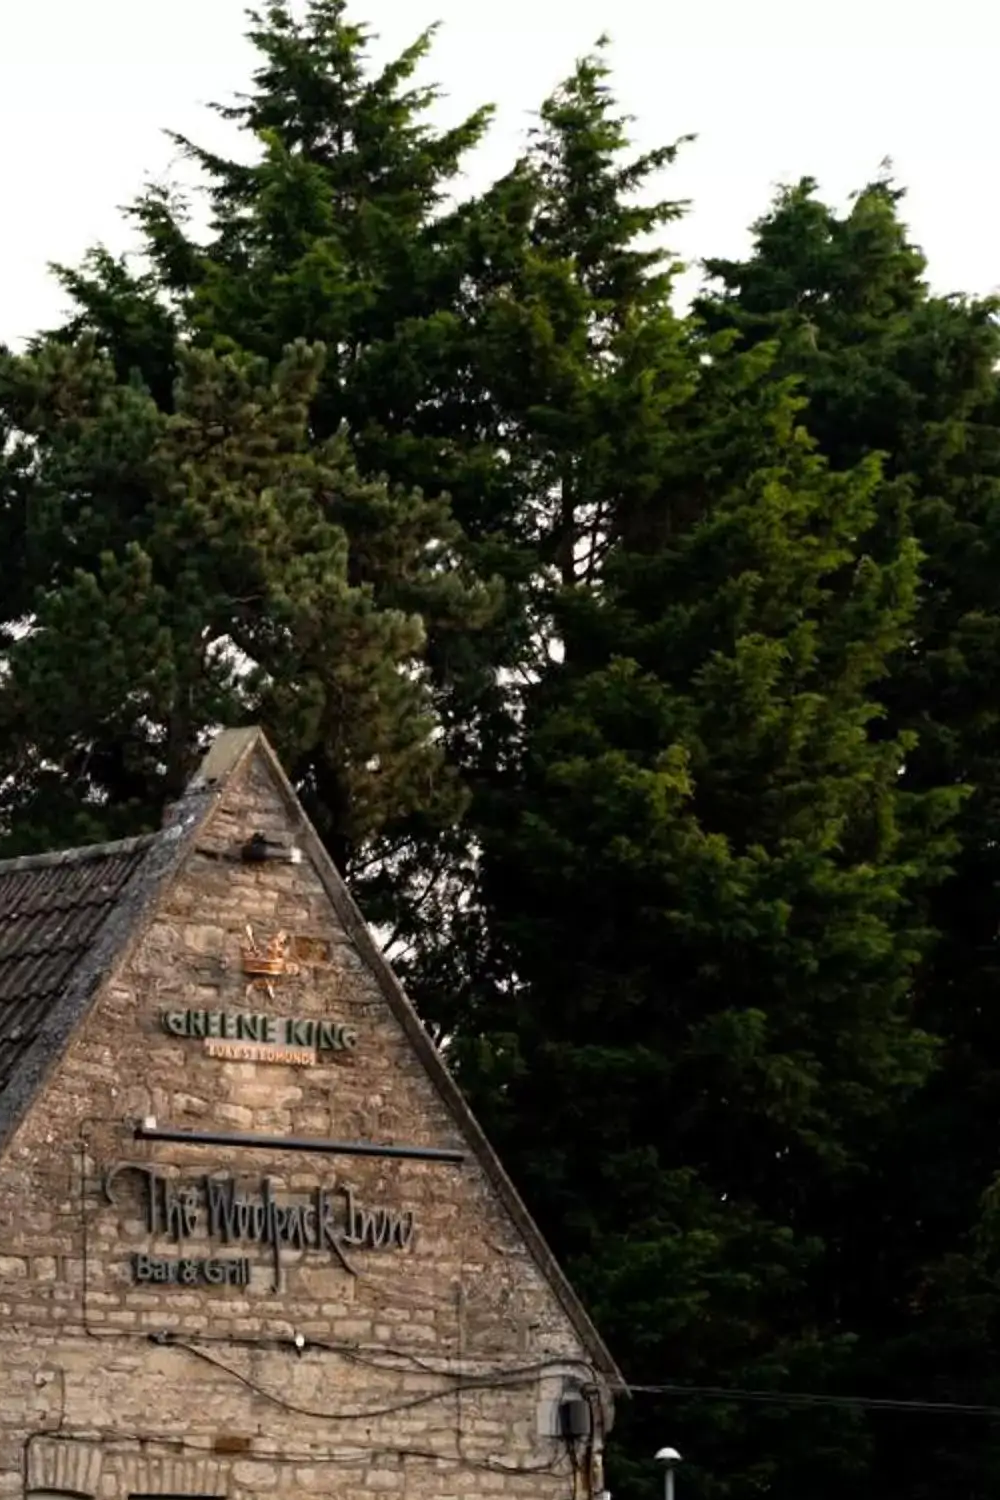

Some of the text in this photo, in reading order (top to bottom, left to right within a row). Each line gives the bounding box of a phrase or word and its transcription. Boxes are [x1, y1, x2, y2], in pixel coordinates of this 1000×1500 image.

[164, 1010, 359, 1050] GREENE KING
[106, 1161, 414, 1294] The Woolpack Inn
[134, 1253, 250, 1286] Bar & Grill
